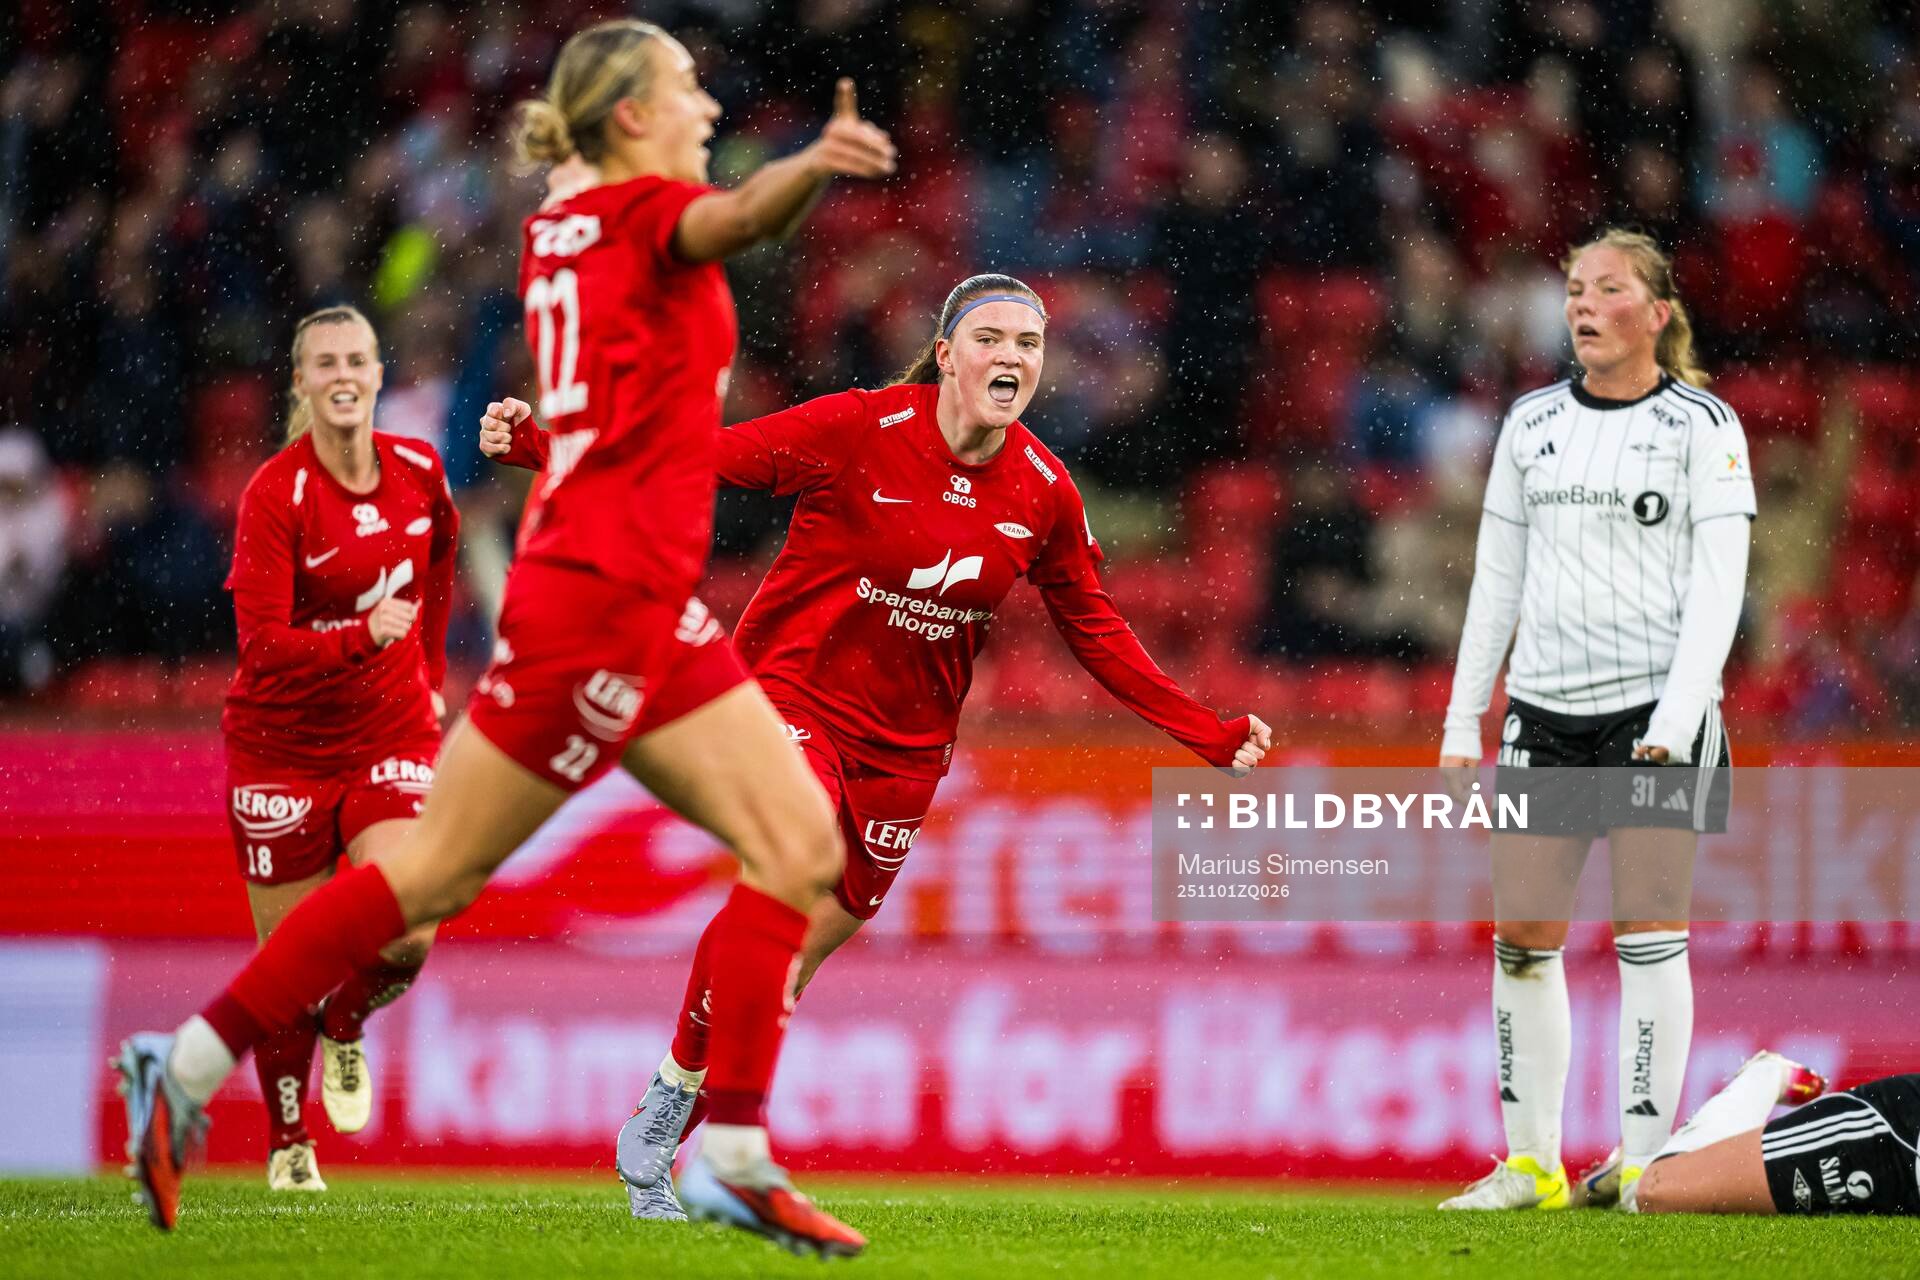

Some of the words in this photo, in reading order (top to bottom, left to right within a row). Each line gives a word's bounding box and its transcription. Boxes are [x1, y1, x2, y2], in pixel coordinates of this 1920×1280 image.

[1525, 402, 1567, 431] HENT
[1648, 403, 1686, 431] HENT
[942, 491, 977, 509] OBOS
[1002, 524, 1027, 536] BRANN
[888, 609, 956, 641] Norge
[370, 759, 434, 785] LERØ
[233, 786, 307, 821] LERØY
[1631, 774, 1656, 808] 31
[247, 844, 273, 878] 18
